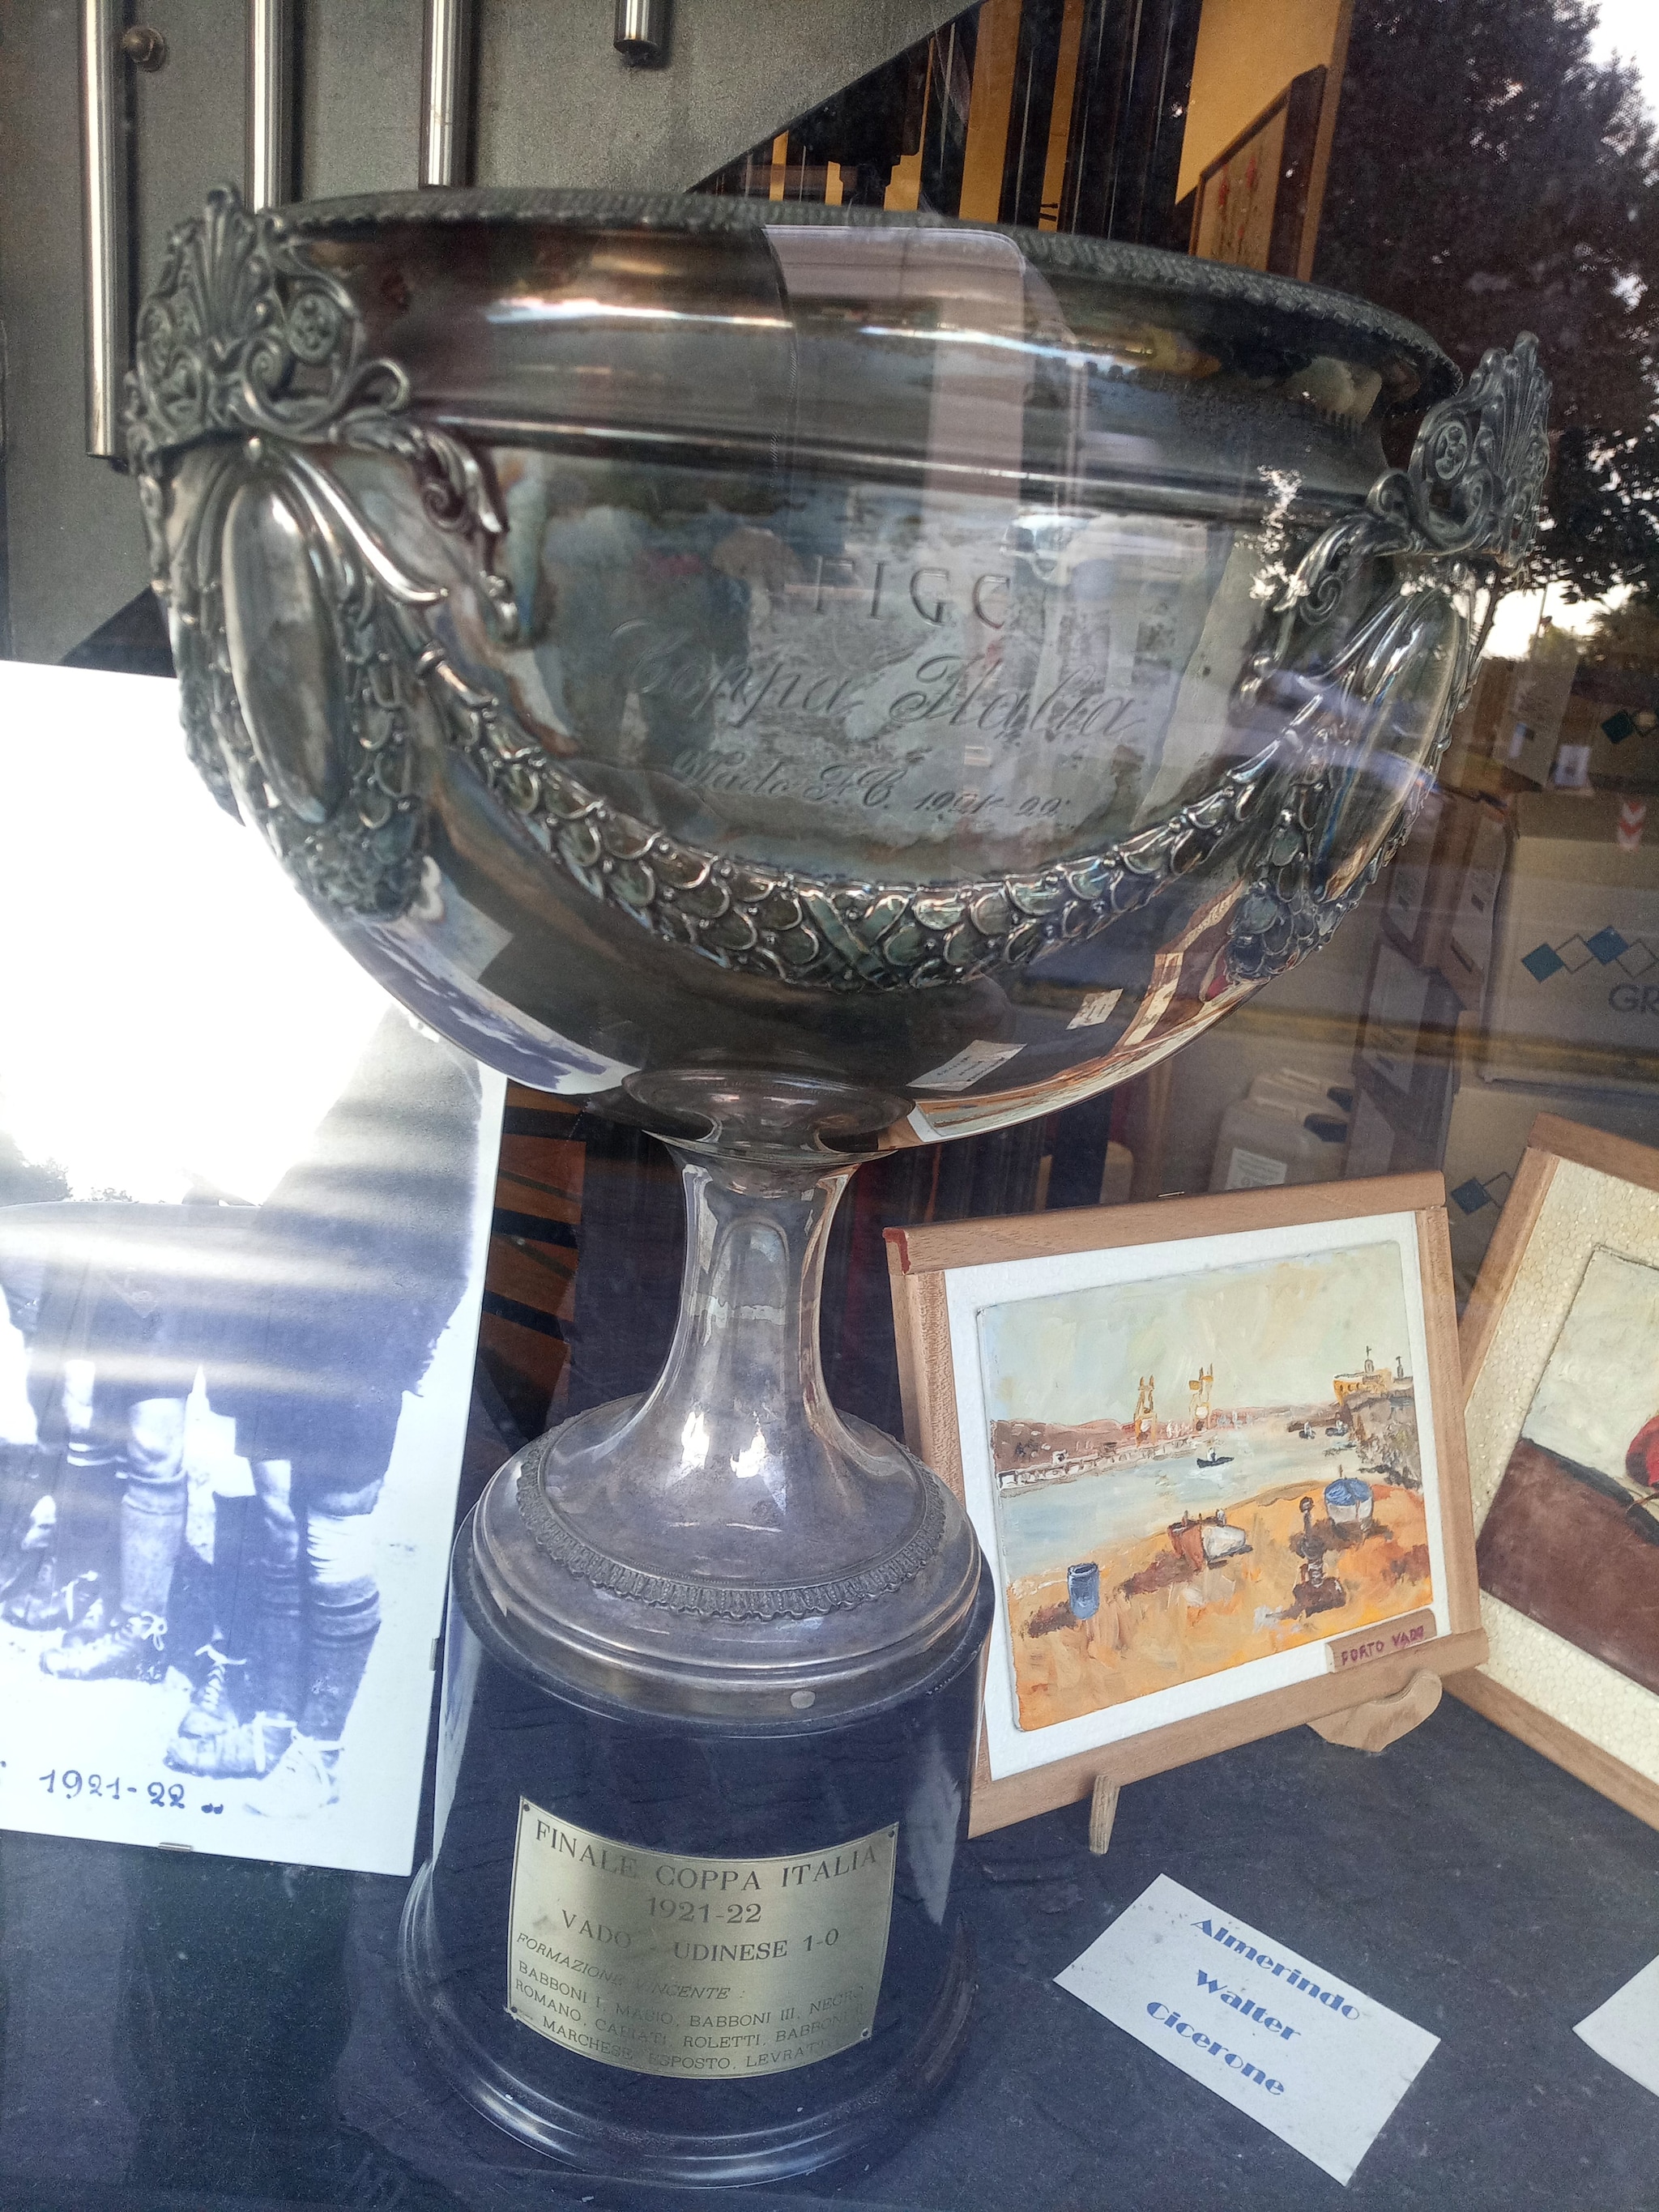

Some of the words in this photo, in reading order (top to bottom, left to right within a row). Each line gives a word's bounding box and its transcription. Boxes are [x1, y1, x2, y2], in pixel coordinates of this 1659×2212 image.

[889, 654, 1145, 733] Italia
[1341, 1640, 1384, 1665] PORTO
[1392, 1626, 1424, 1647] VADO
[535, 1819, 637, 1878] FINALE
[655, 1865, 761, 1891] COPPA
[781, 1844, 876, 1888] ITALIA
[561, 1909, 631, 1949] VADO
[674, 1939, 788, 1962] UDINESE
[803, 1928, 839, 1952] 1-0
[647, 1897, 762, 1924] 1921-22
[518, 1959, 587, 2004] BABBONI
[689, 2011, 772, 2028] BABBONI
[1190, 1919, 1360, 2020] Almerindo
[1196, 1969, 1302, 2040] Walter
[543, 2015, 633, 2061] MARCHESE
[1146, 2001, 1285, 2095] Cicerone
